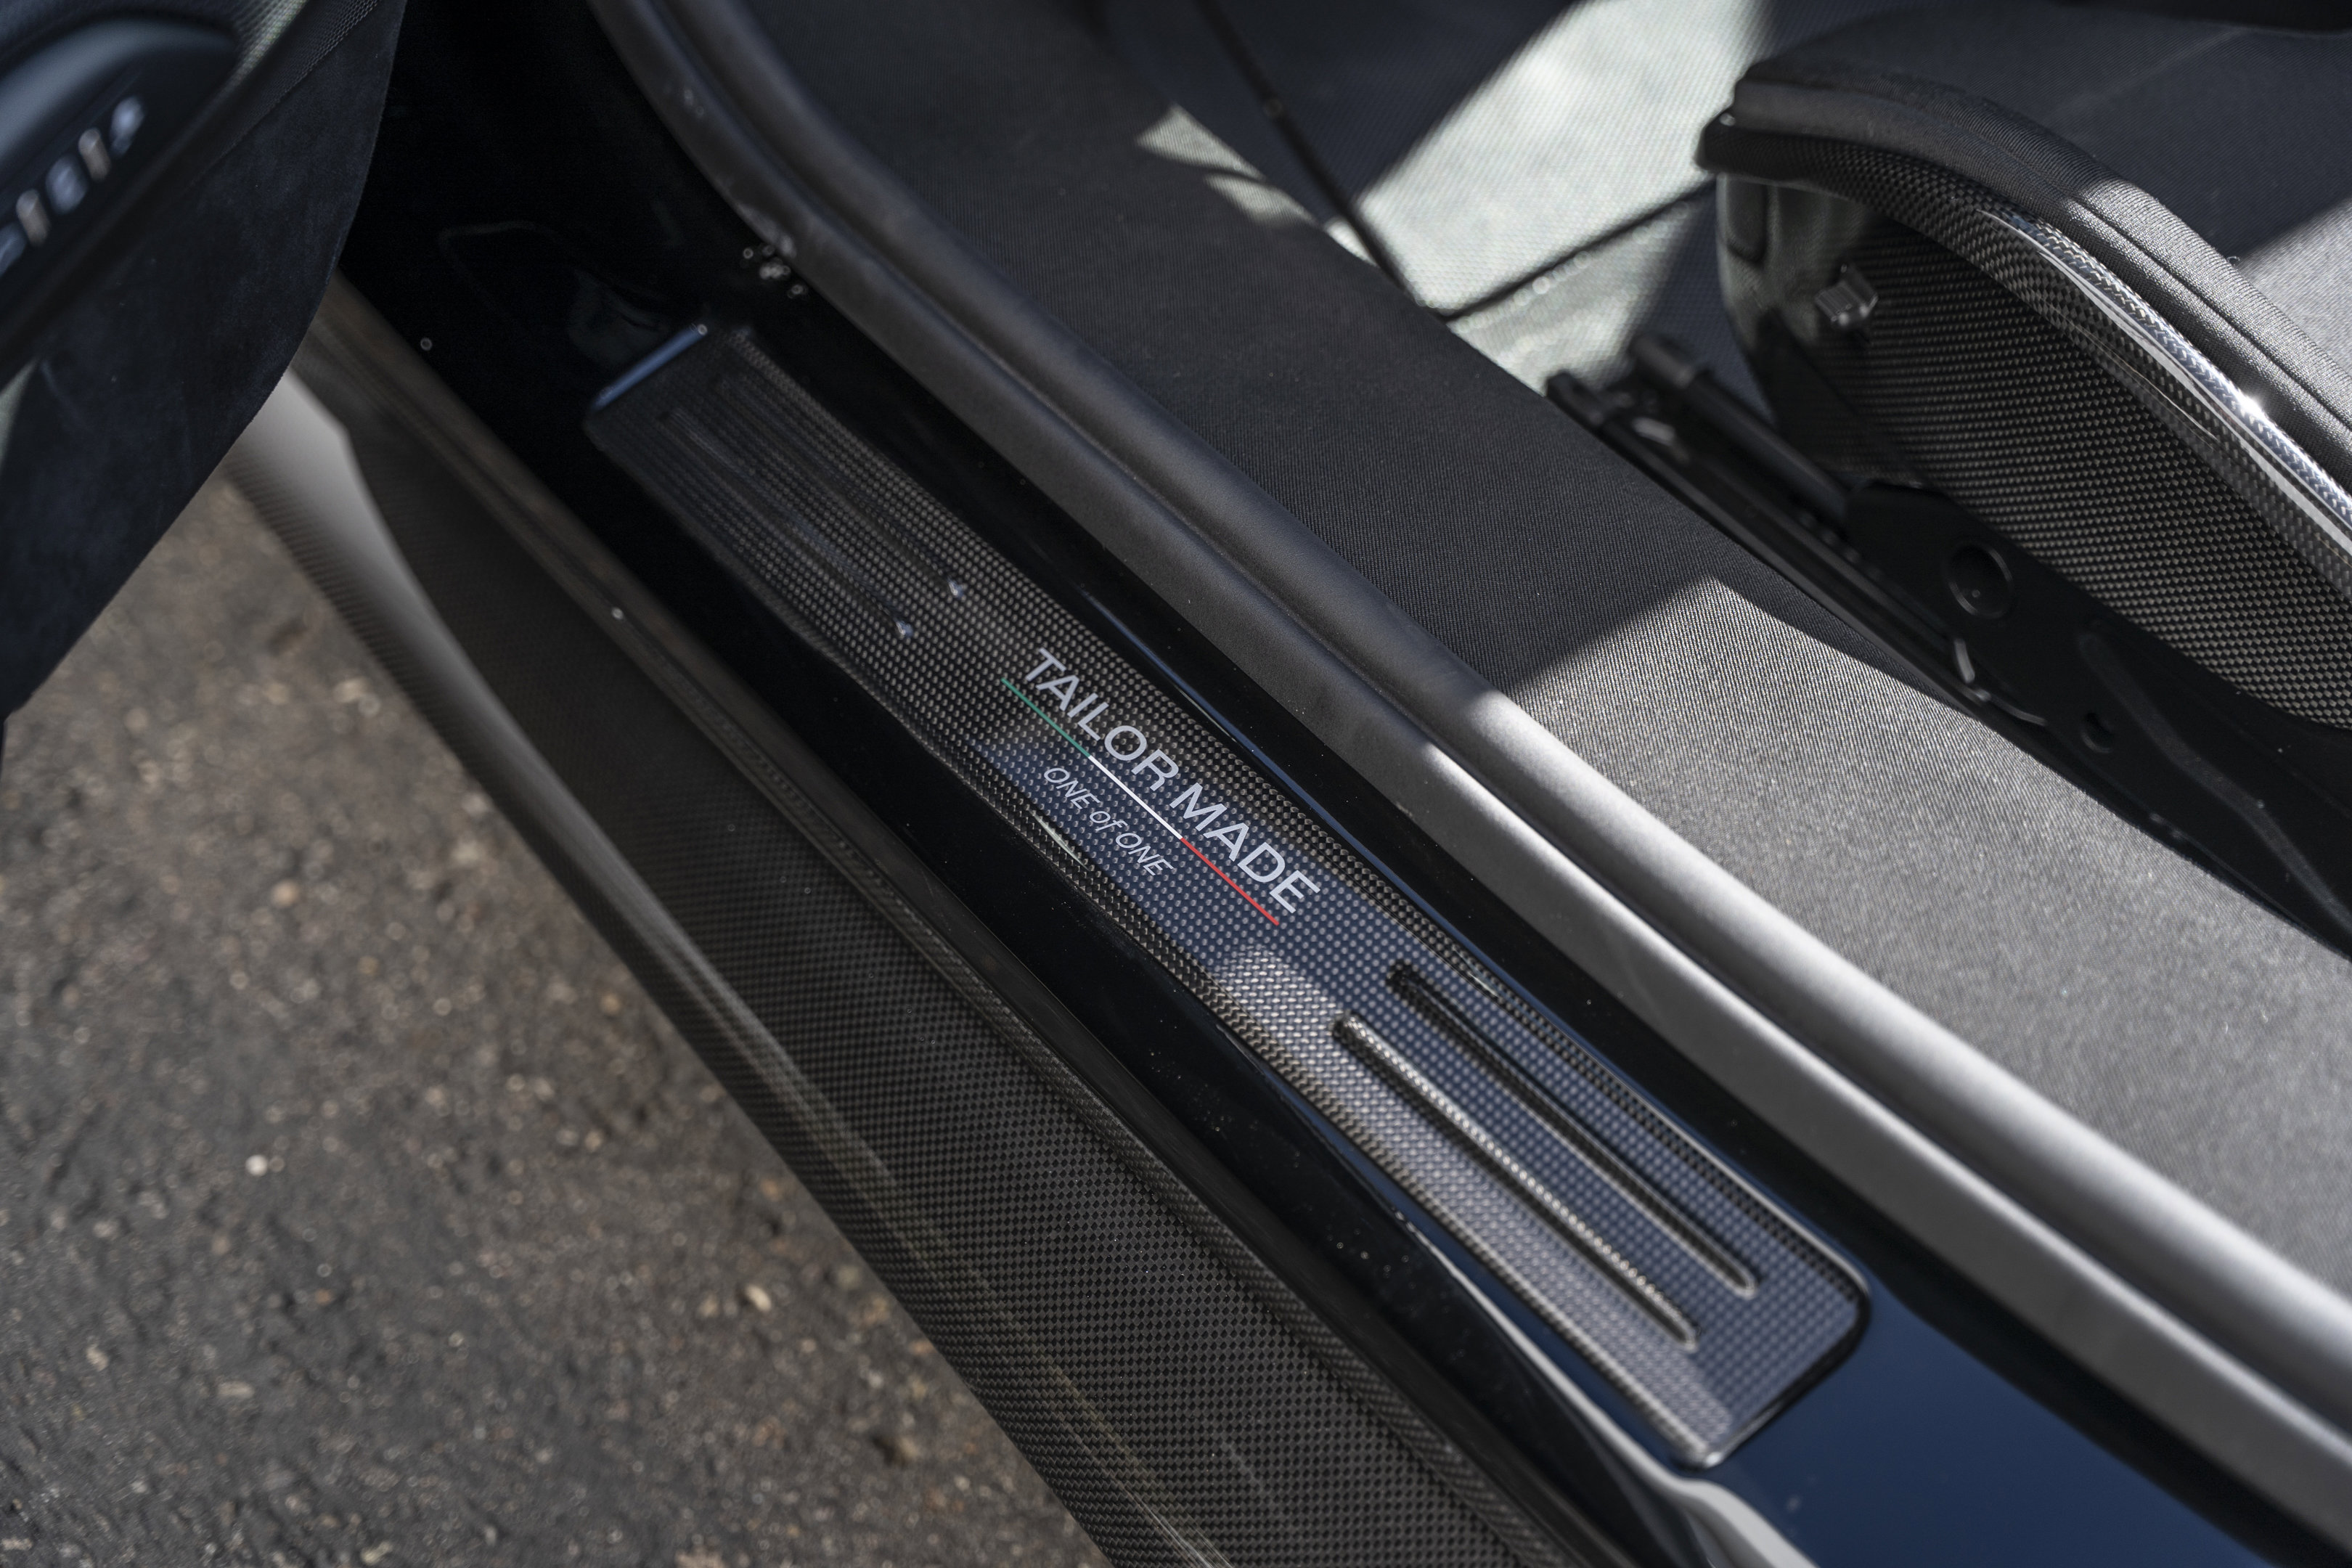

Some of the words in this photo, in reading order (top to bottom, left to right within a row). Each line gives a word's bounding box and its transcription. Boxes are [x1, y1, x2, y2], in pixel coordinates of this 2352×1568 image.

[1025, 648, 1179, 791] TAILOR
[1170, 783, 1320, 913] MADE
[1044, 768, 1101, 809] ONE
[1090, 811, 1128, 831] of
[1116, 833, 1174, 875] ONE
